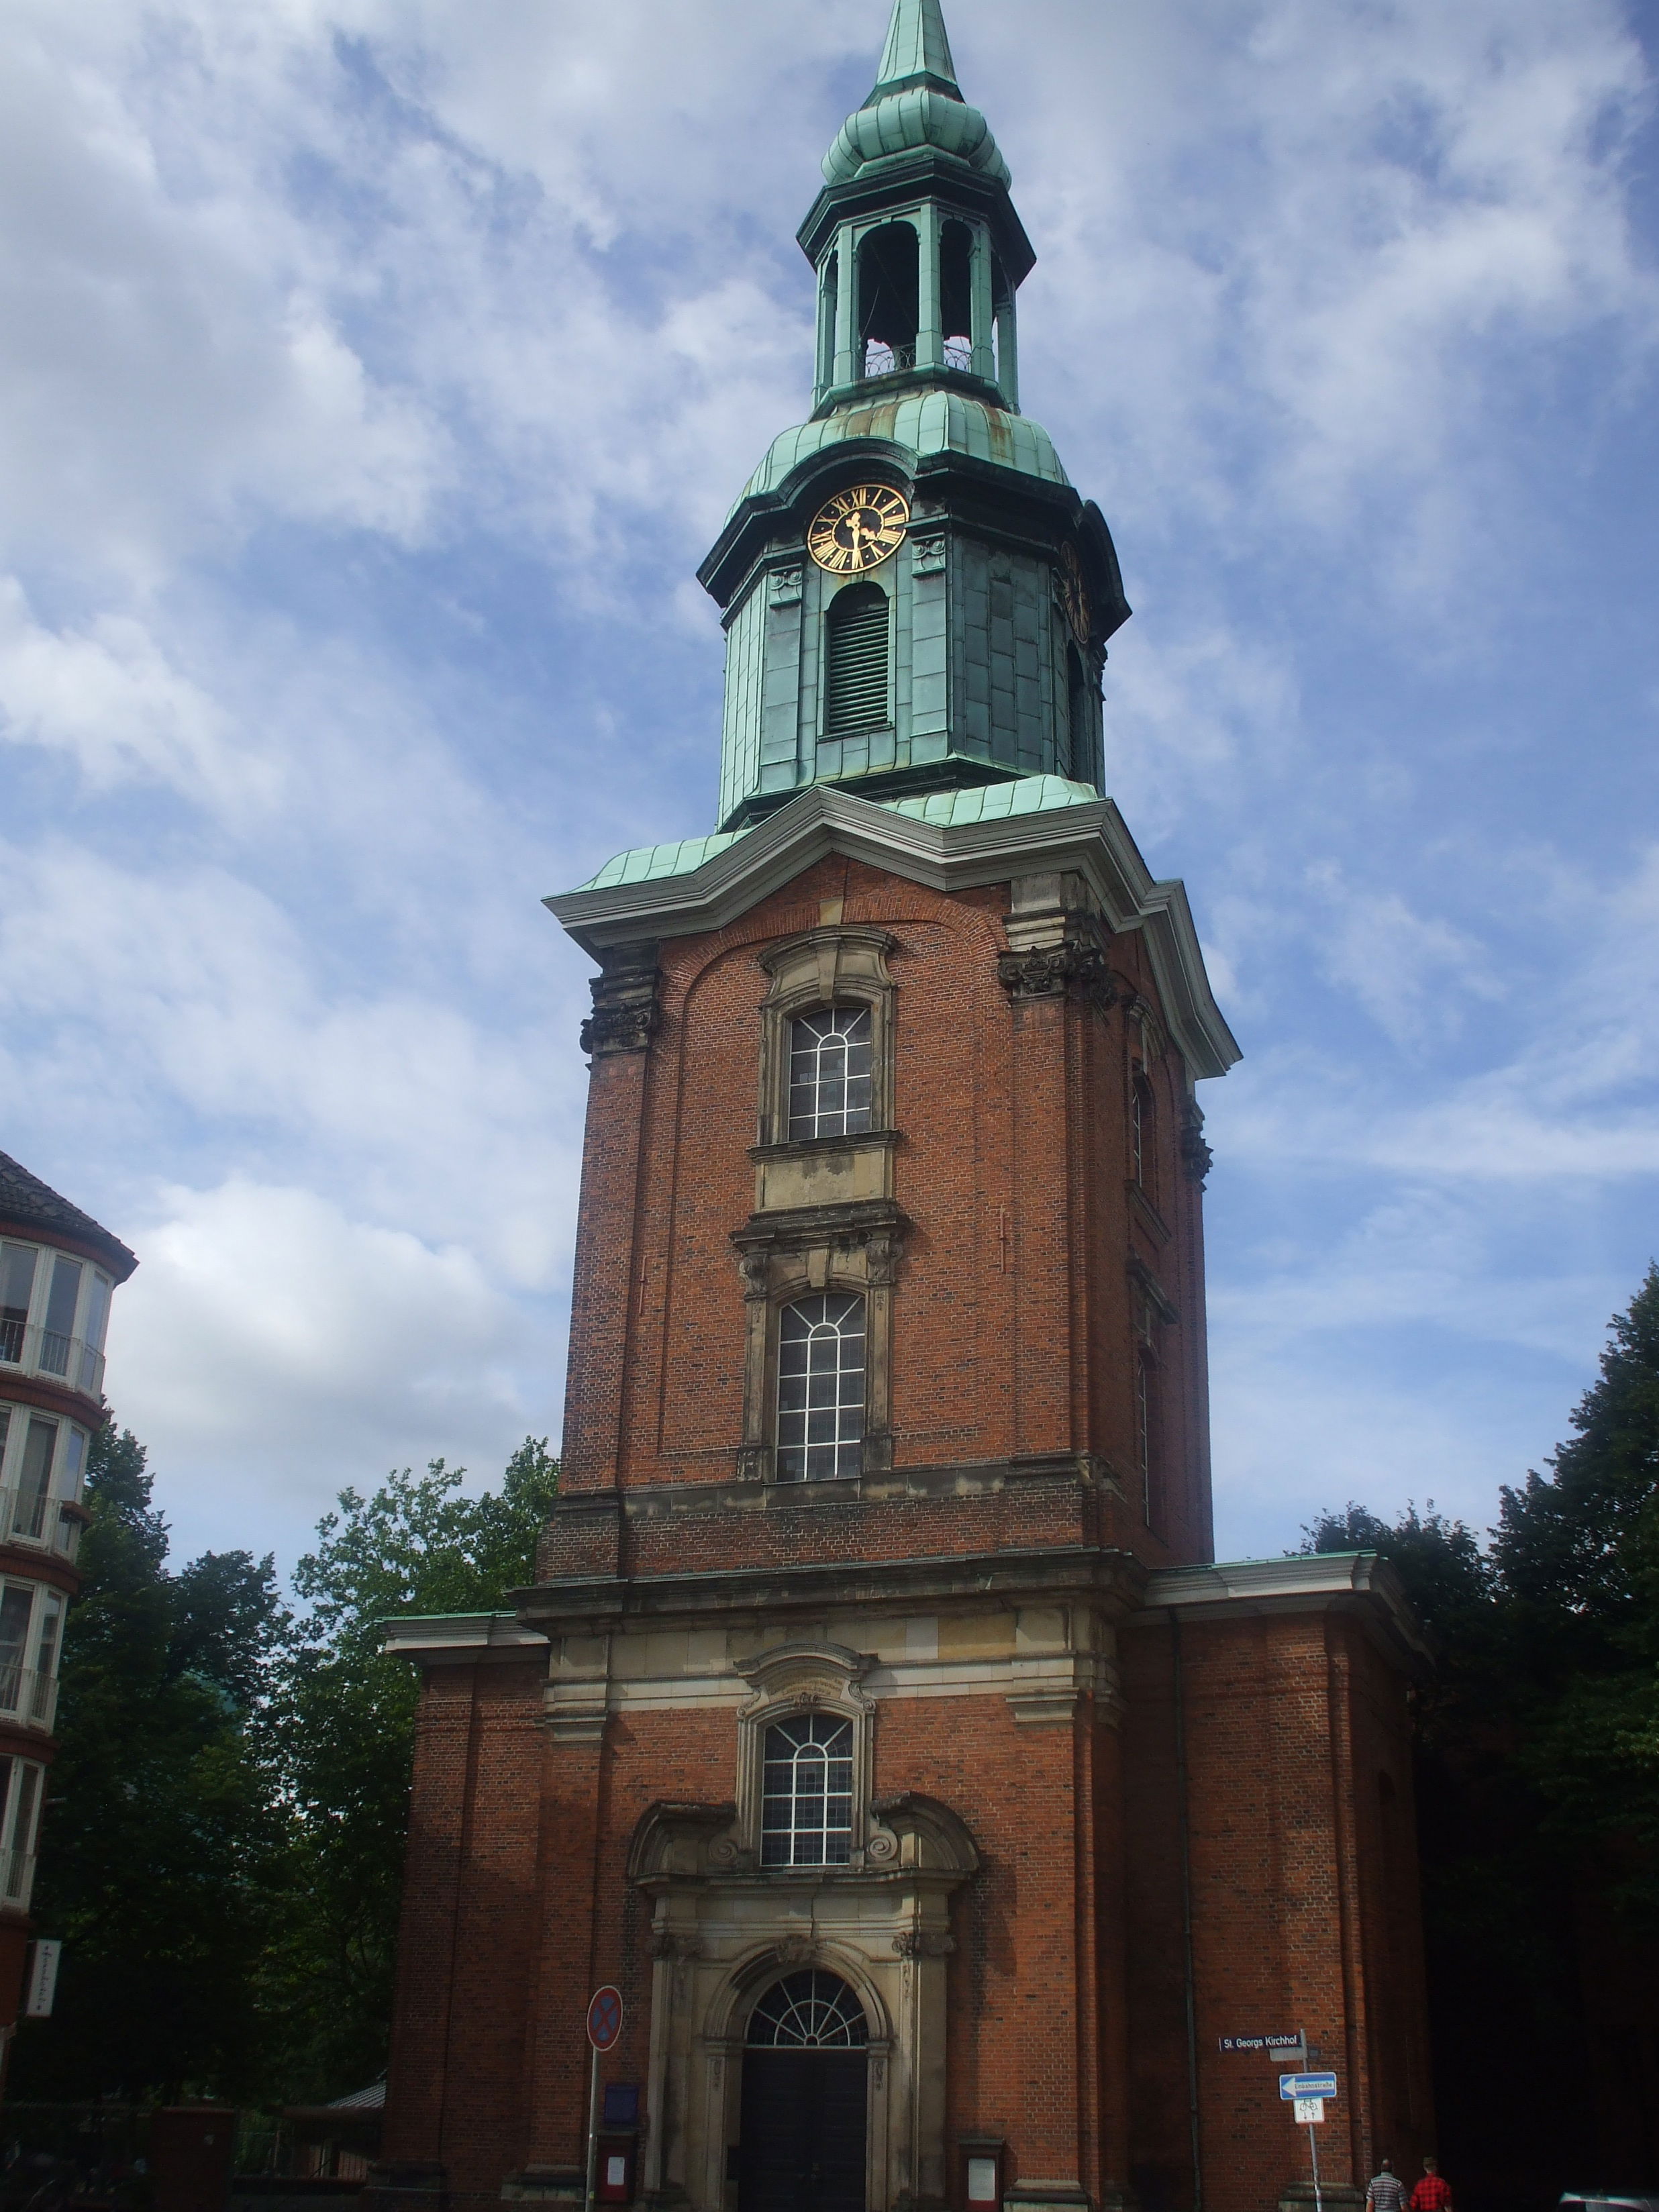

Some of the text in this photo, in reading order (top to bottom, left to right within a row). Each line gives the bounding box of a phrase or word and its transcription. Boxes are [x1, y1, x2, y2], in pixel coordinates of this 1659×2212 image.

[879, 497, 901, 514] II
[816, 514, 838, 526] X
[883, 512, 905, 527] III
[1224, 2034, 1297, 2049] St. Georgs Kirchhof
[1294, 2081, 1333, 2089] Einbahnstraße
